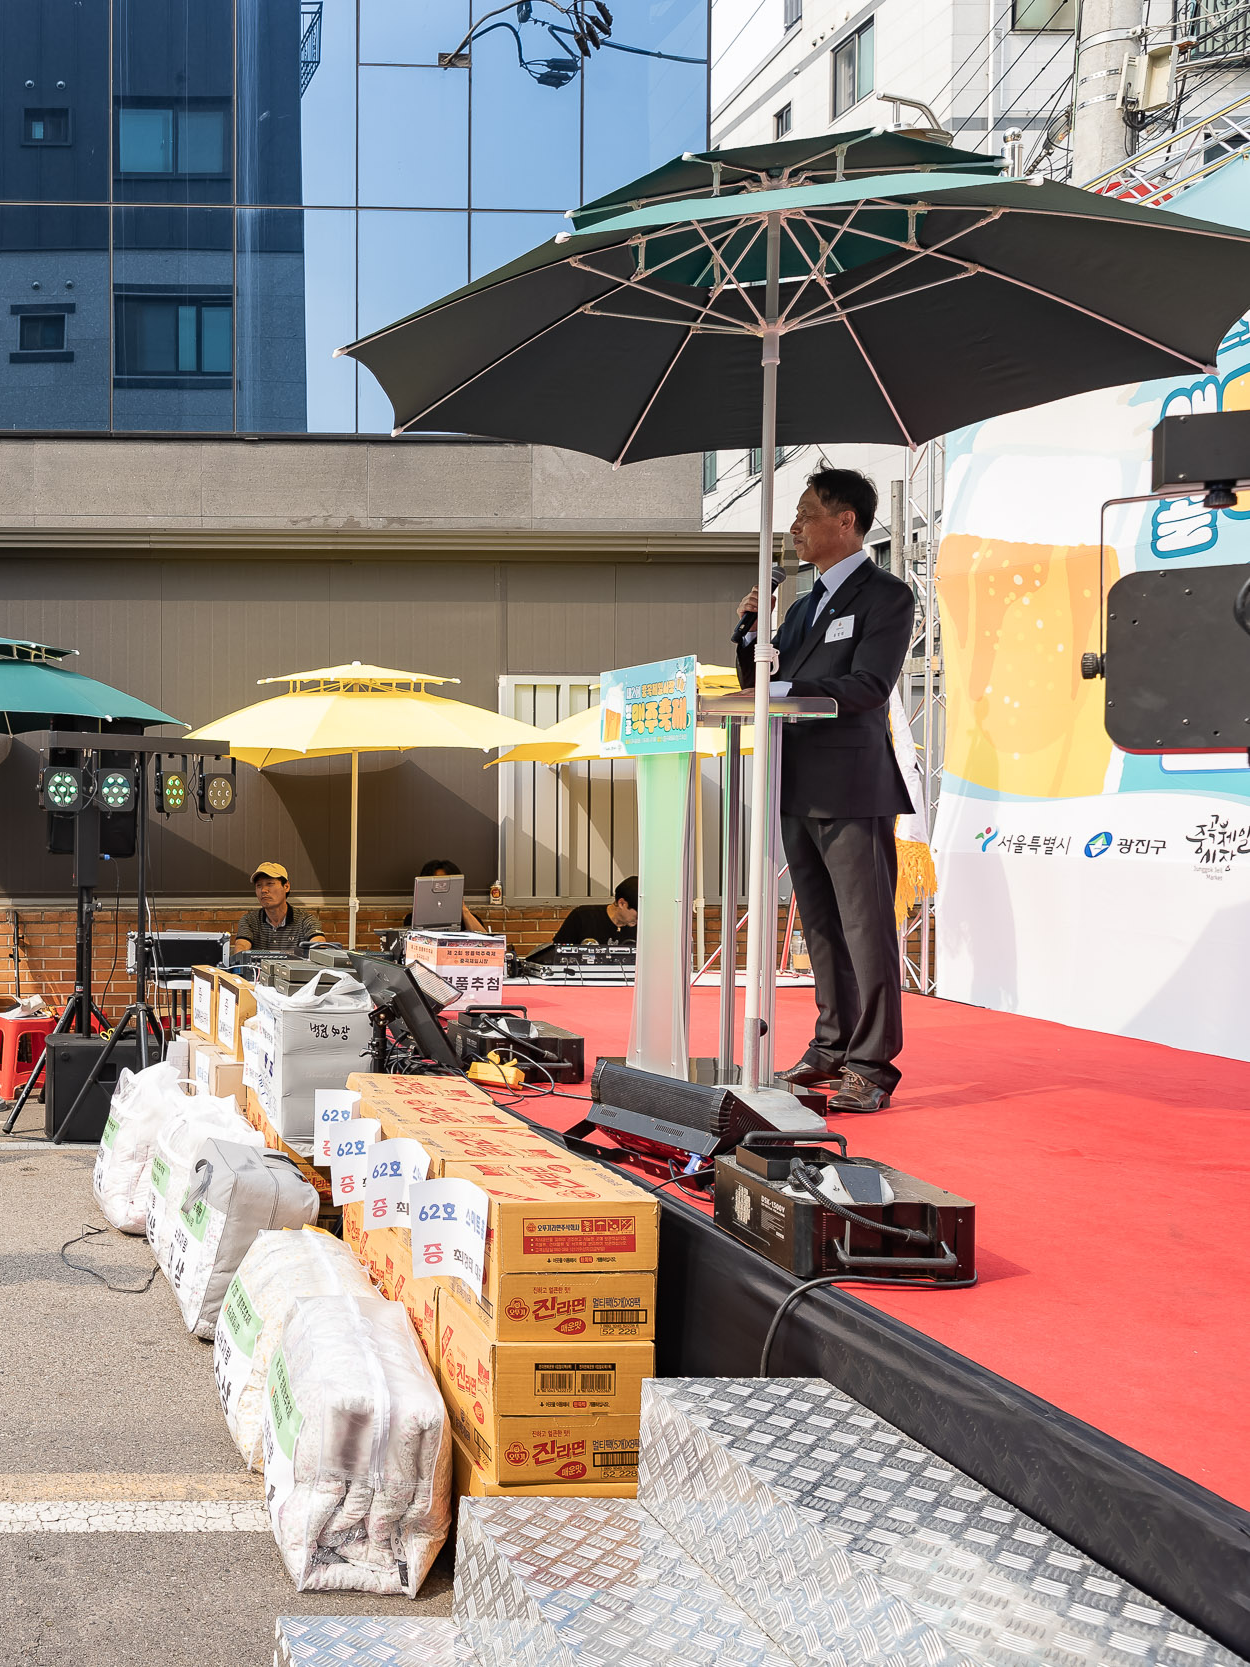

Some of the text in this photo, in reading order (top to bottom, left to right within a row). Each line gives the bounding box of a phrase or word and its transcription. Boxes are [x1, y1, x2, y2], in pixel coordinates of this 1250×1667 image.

[997, 834, 1072, 856] 서울특별시
[1116, 838, 1167, 856] 광진구
[336, 1139, 367, 1157] 62호
[371, 1160, 403, 1179] 62호
[339, 1174, 355, 1194] 증
[371, 1197, 388, 1218] 증
[418, 1202, 458, 1222] 62호
[423, 1242, 444, 1265] 증
[532, 1296, 587, 1322] 진라면
[560, 1320, 637, 1336] 매운맛 52 228
[456, 1362, 477, 1397] 진라면
[532, 1439, 587, 1466] 진라면
[561, 1464, 583, 1477] 매운맛
[603, 1470, 616, 1478] 52
